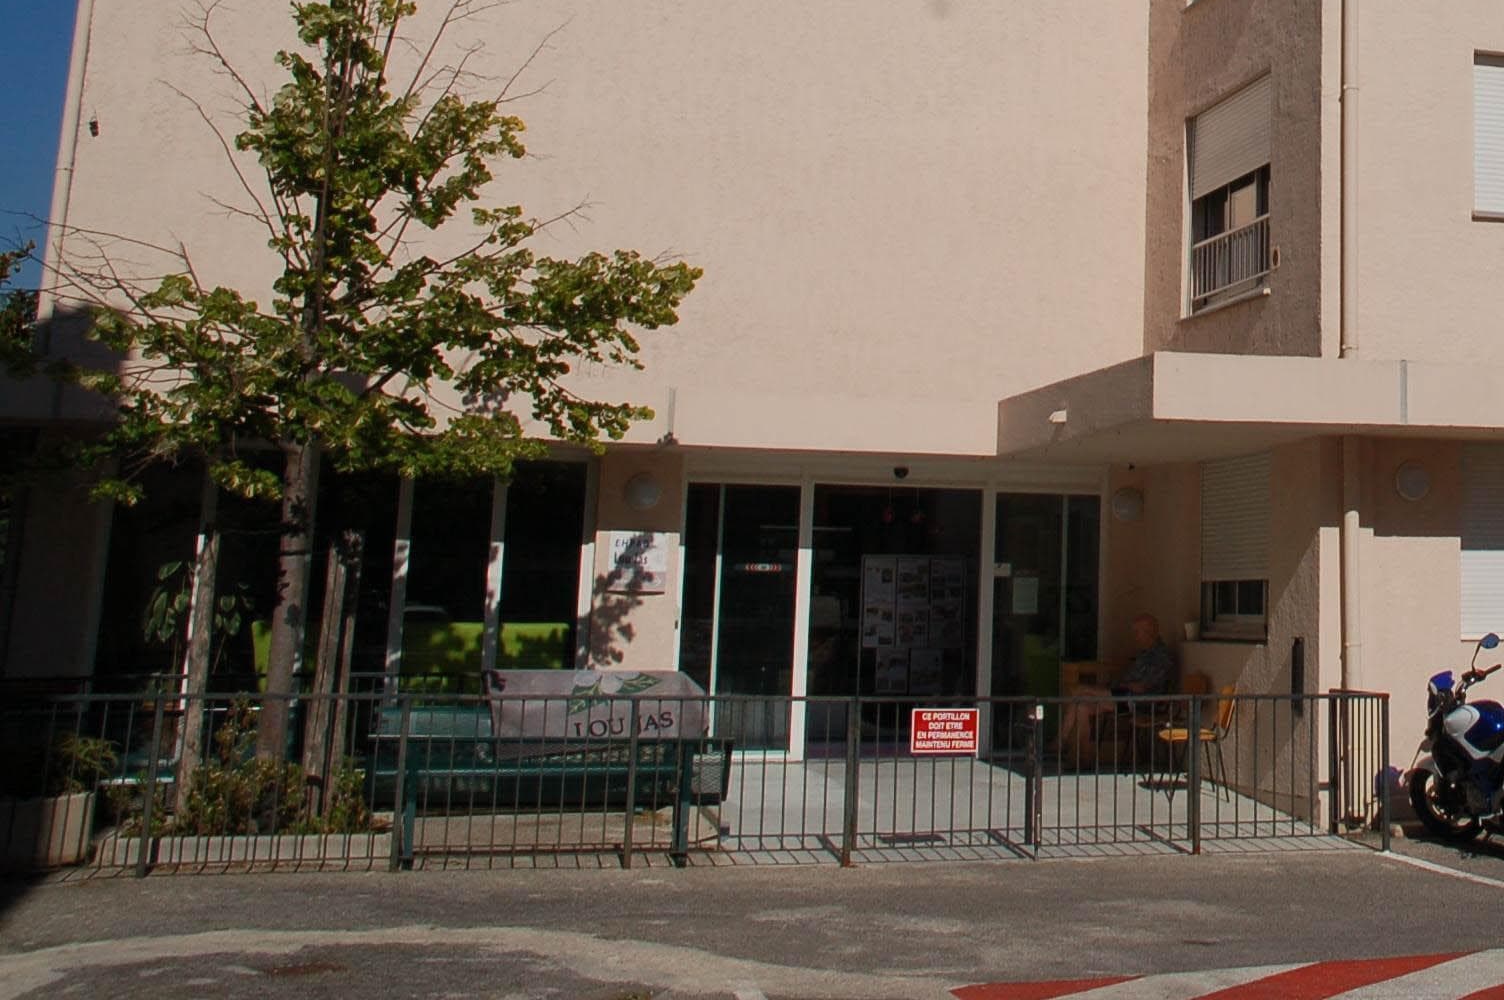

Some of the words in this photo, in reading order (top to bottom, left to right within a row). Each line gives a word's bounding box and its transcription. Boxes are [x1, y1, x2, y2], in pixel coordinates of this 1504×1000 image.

[922, 712, 931, 720] CE
[933, 712, 970, 720] PORTILLON
[928, 722, 945, 730] DOIT
[917, 731, 927, 739] EN
[928, 731, 974, 739] PERMANENCE
[915, 740, 951, 748] MAINTENU
